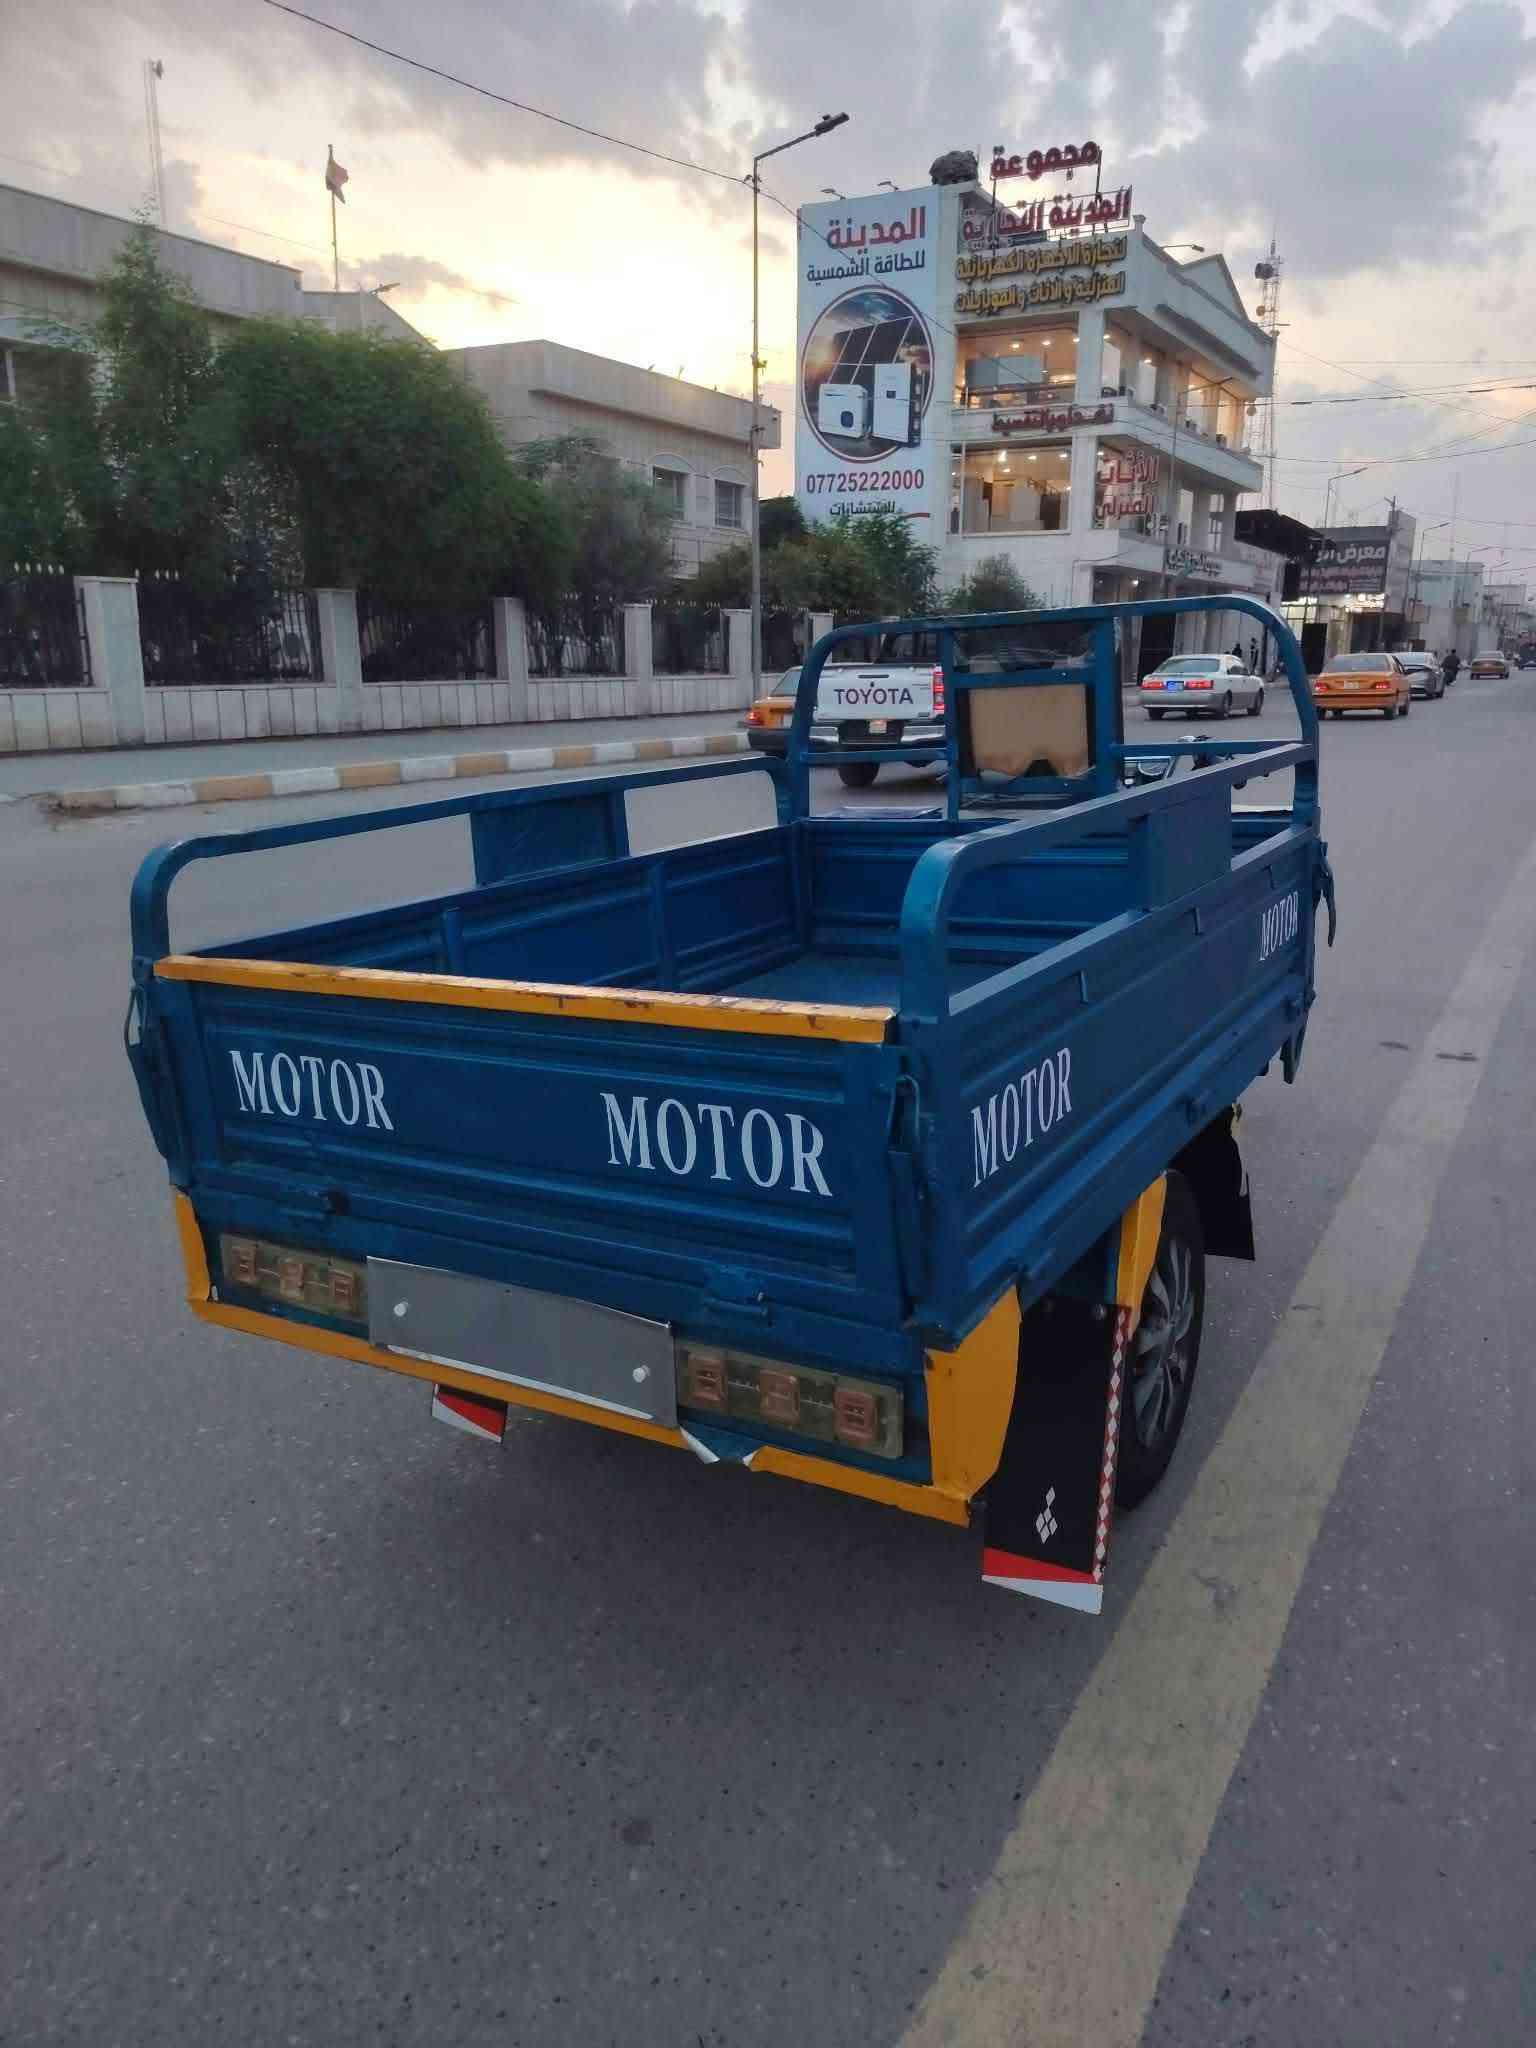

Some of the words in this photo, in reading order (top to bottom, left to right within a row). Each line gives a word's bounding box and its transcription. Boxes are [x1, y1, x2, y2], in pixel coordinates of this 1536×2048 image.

[990, 141, 1100, 180] مجموعة
[827, 206, 926, 254] المدينة
[1049, 184, 1132, 236] المدينة
[806, 257, 869, 286] الشمسية
[874, 249, 925, 274] للطاقة
[806, 469, 925, 493] 07725222000
[834, 688, 914, 705] TOYOTA
[1259, 890, 1299, 961] MOTOR
[229, 1050, 394, 1131] MOTOR
[970, 1047, 1072, 1188] MOTOR
[600, 1092, 832, 1197] MOTOR
